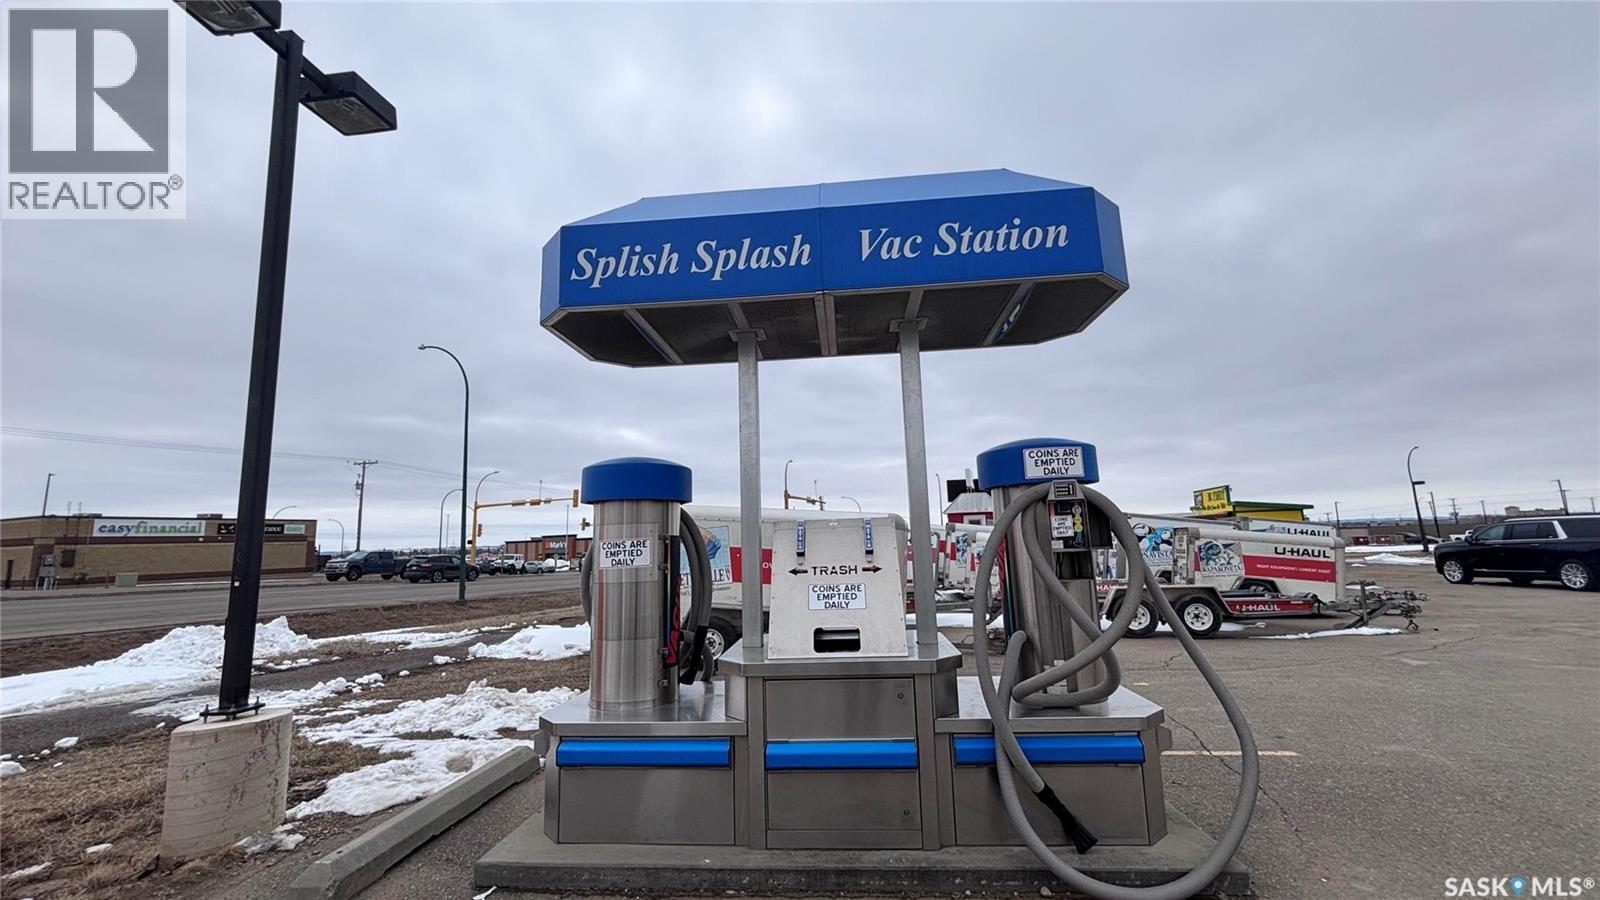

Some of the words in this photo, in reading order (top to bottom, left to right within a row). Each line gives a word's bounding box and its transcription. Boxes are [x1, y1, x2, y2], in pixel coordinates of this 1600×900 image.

[570, 242, 679, 288] Splish
[690, 234, 812, 281] Splash
[858, 228, 922, 262] Vac
[933, 217, 1069, 257] Station
[1028, 449, 1060, 459] COINS
[1062, 448, 1079, 458] ARE
[1034, 458, 1076, 468] EMPTIED
[1043, 466, 1070, 476] DAILY
[98, 520, 202, 537] easyfinancial
[602, 541, 627, 550] COINS
[630, 539, 648, 549] ARE
[605, 549, 643, 559] EMPTIED
[1274, 546, 1331, 559] U-HAUL
[611, 557, 636, 567] DAILY
[811, 565, 858, 576] TRASH
[812, 584, 841, 593] COINS
[844, 584, 862, 592] ARE
[817, 592, 858, 601] EMPTIED
[824, 600, 851, 609] DAILY
